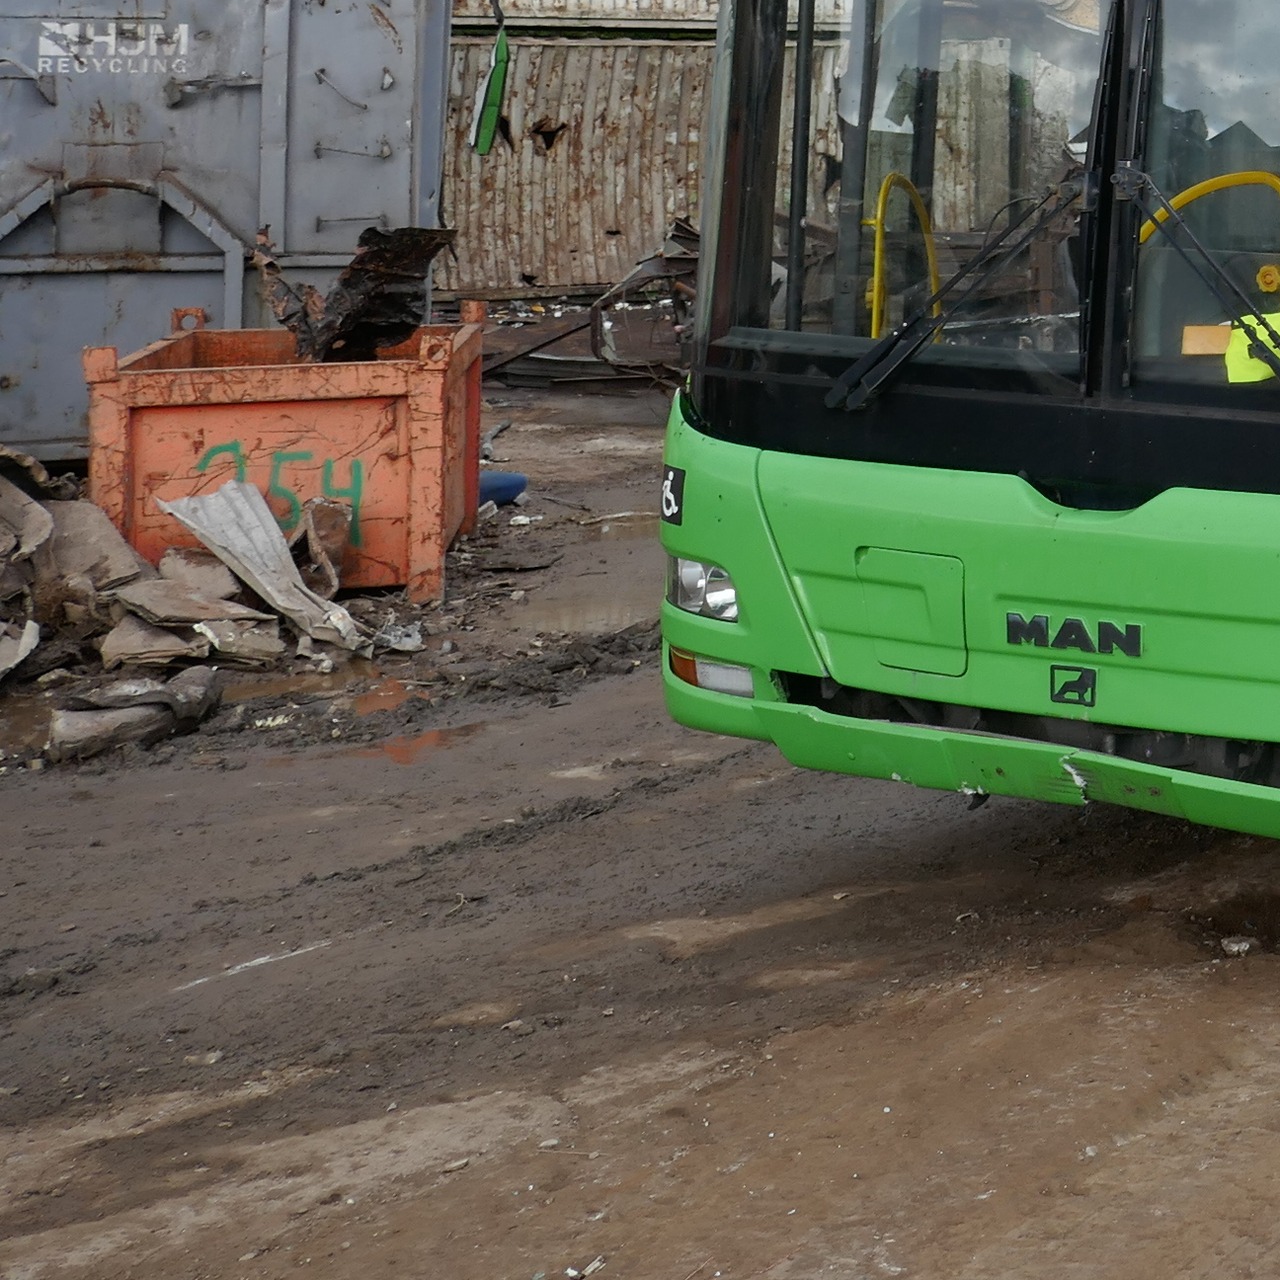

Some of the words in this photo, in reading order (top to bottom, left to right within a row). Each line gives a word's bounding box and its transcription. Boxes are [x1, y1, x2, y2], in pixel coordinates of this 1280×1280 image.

[86, 23, 188, 56] HJM
[38, 58, 187, 73] RECYCLING
[1006, 612, 1142, 658] MAN
